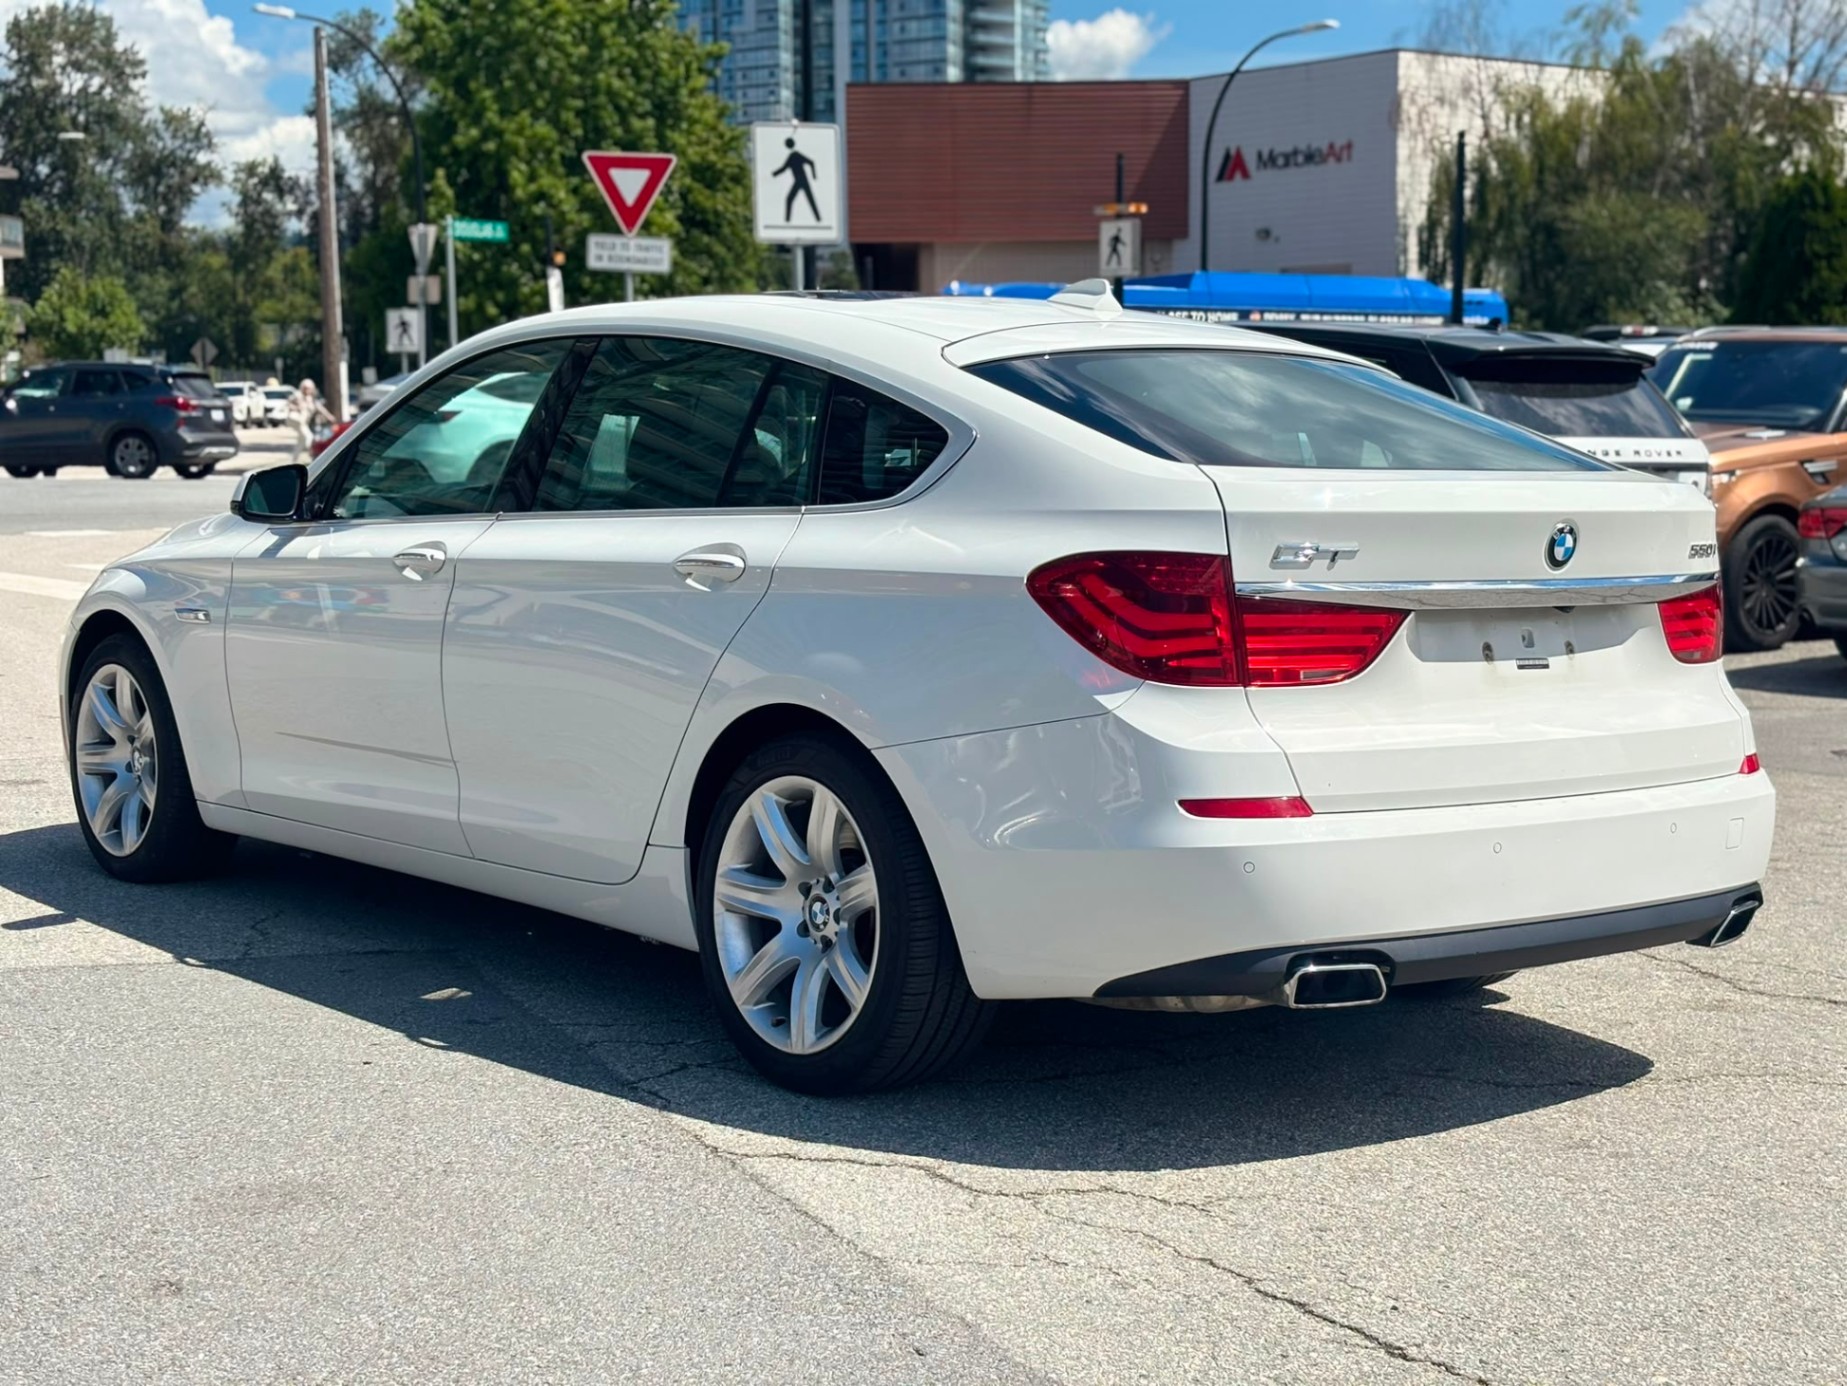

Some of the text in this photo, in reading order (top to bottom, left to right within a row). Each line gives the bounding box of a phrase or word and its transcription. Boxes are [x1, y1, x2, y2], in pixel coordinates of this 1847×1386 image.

[1257, 139, 1353, 171] MarbleArt
[1587, 449, 1682, 457] NGE ROVER
[1269, 542, 1360, 571] GT
